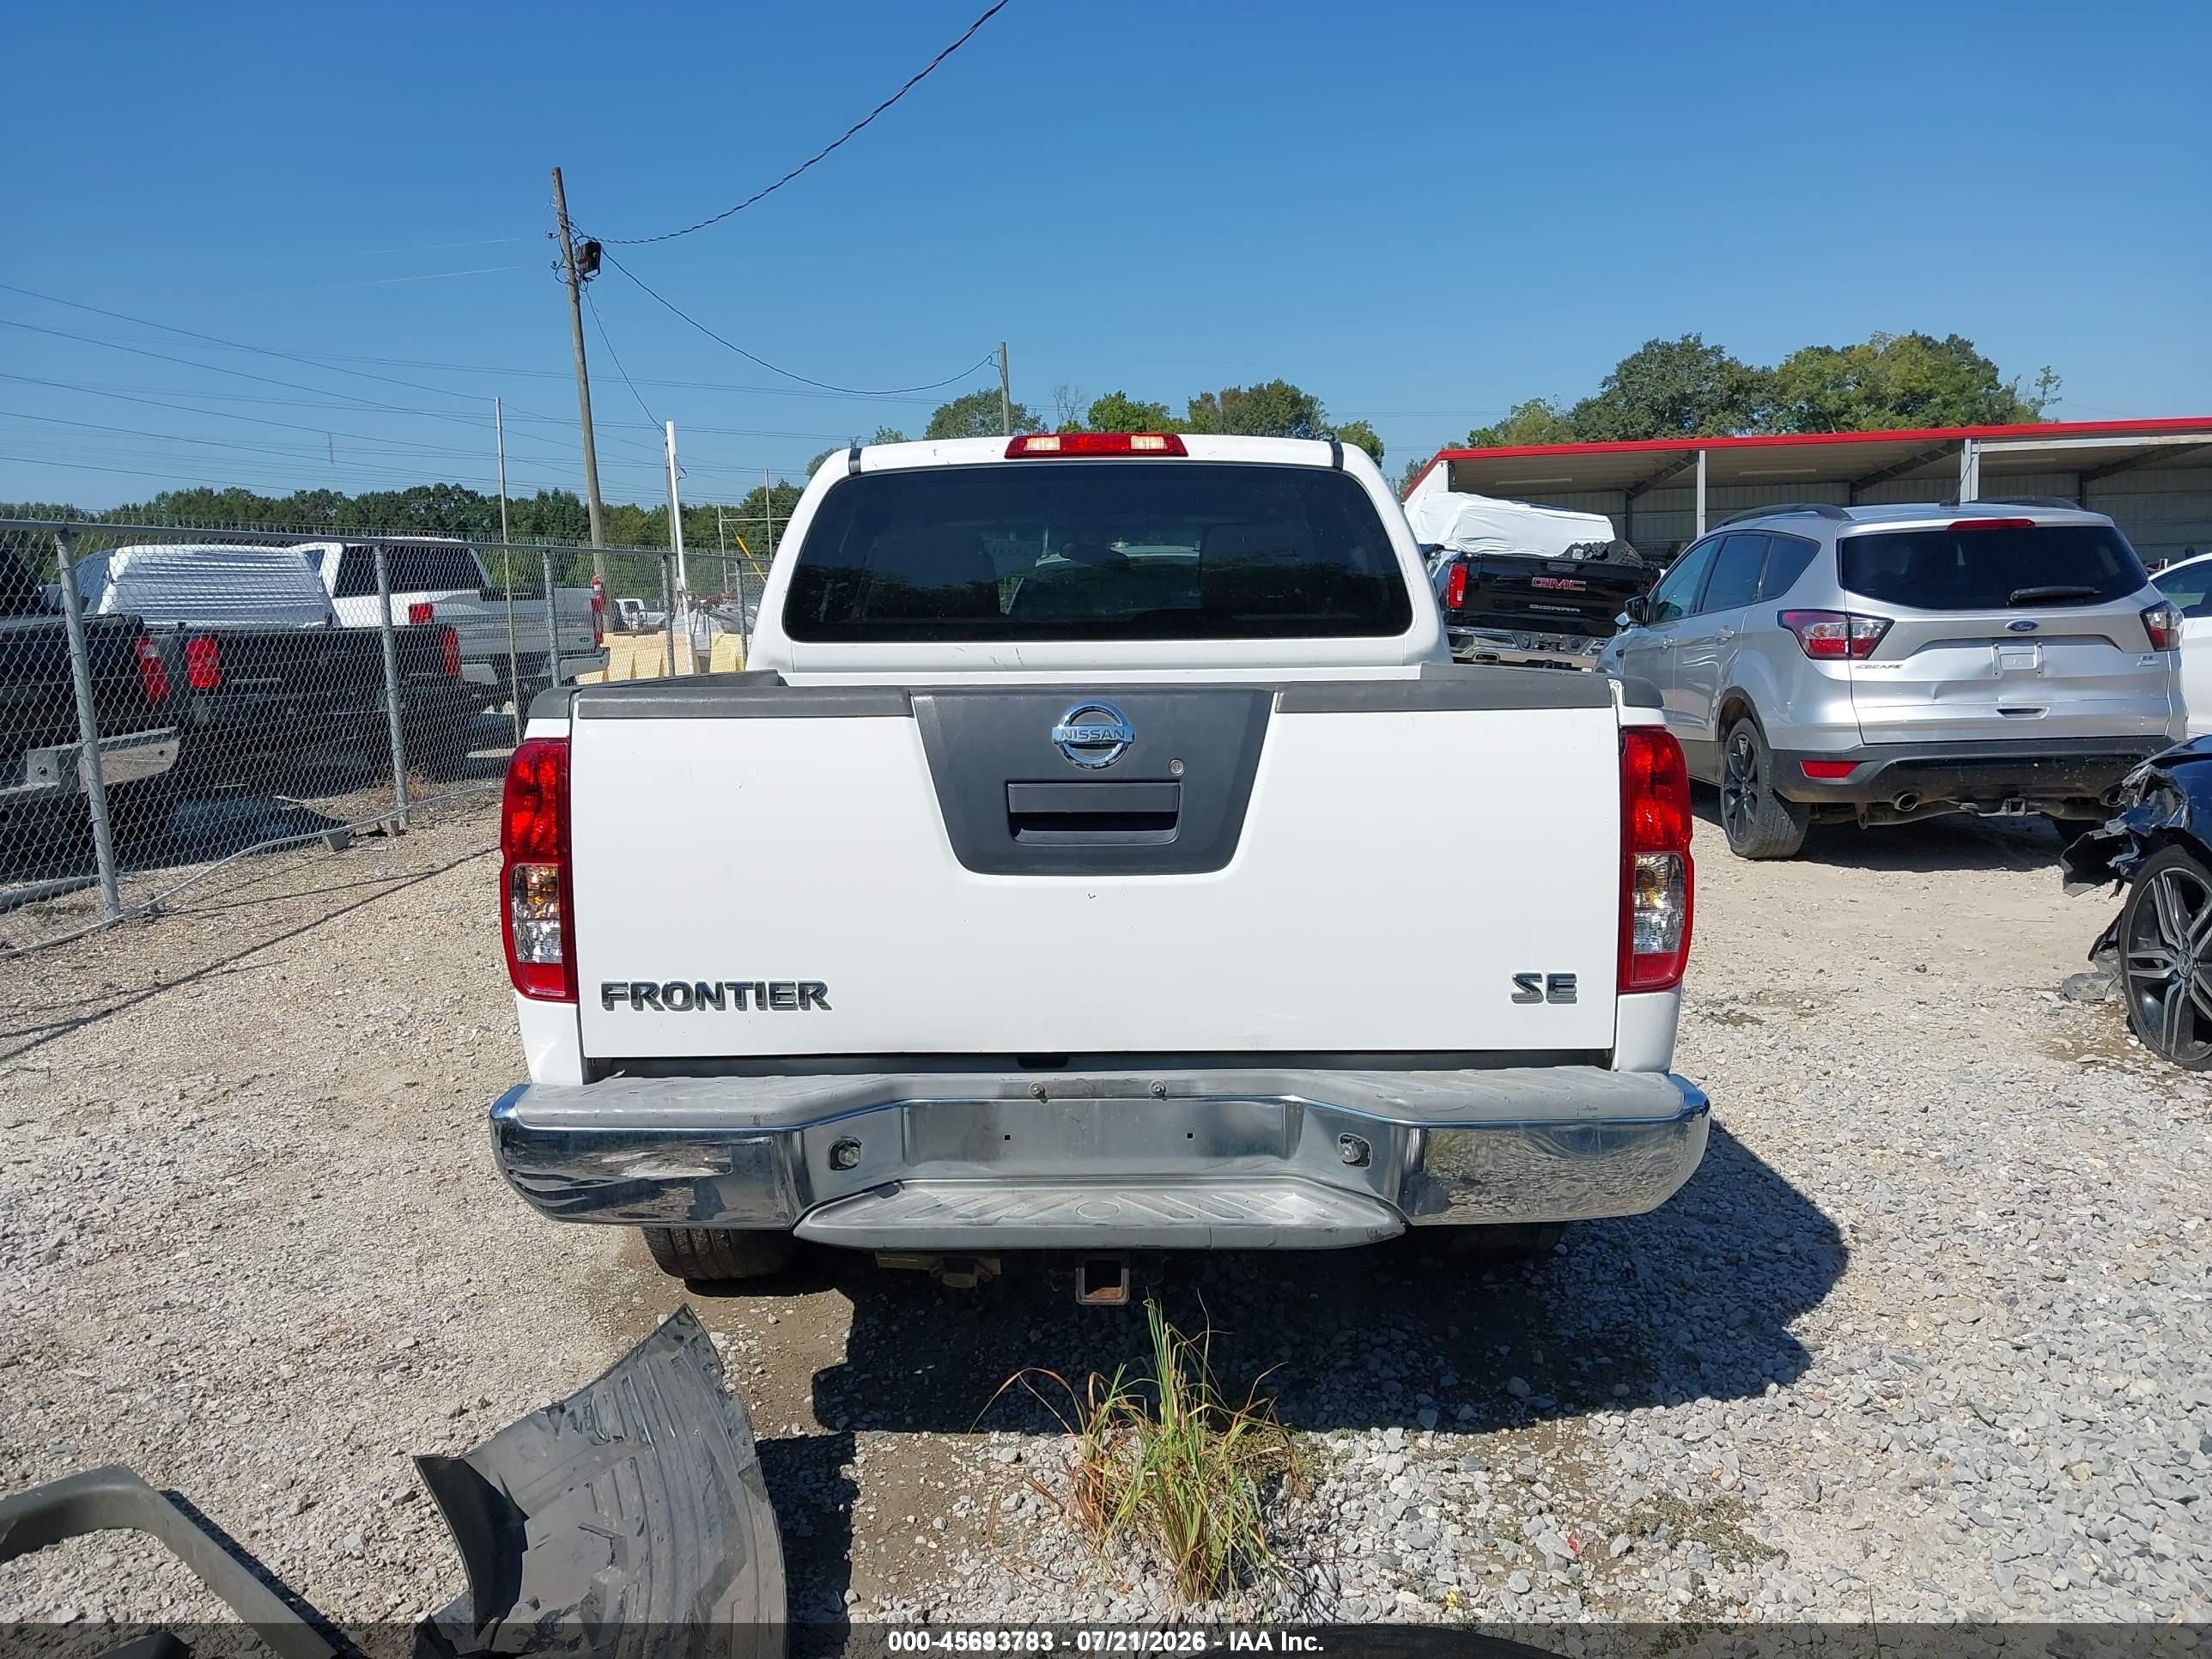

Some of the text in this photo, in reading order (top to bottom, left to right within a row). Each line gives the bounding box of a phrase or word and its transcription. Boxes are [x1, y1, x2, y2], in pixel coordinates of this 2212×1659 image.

[1531, 577, 1587, 591] GMC
[1060, 730, 1126, 740] NISSAN
[600, 981, 833, 1012] FRONTIER
[1510, 972, 1577, 1005] SE
